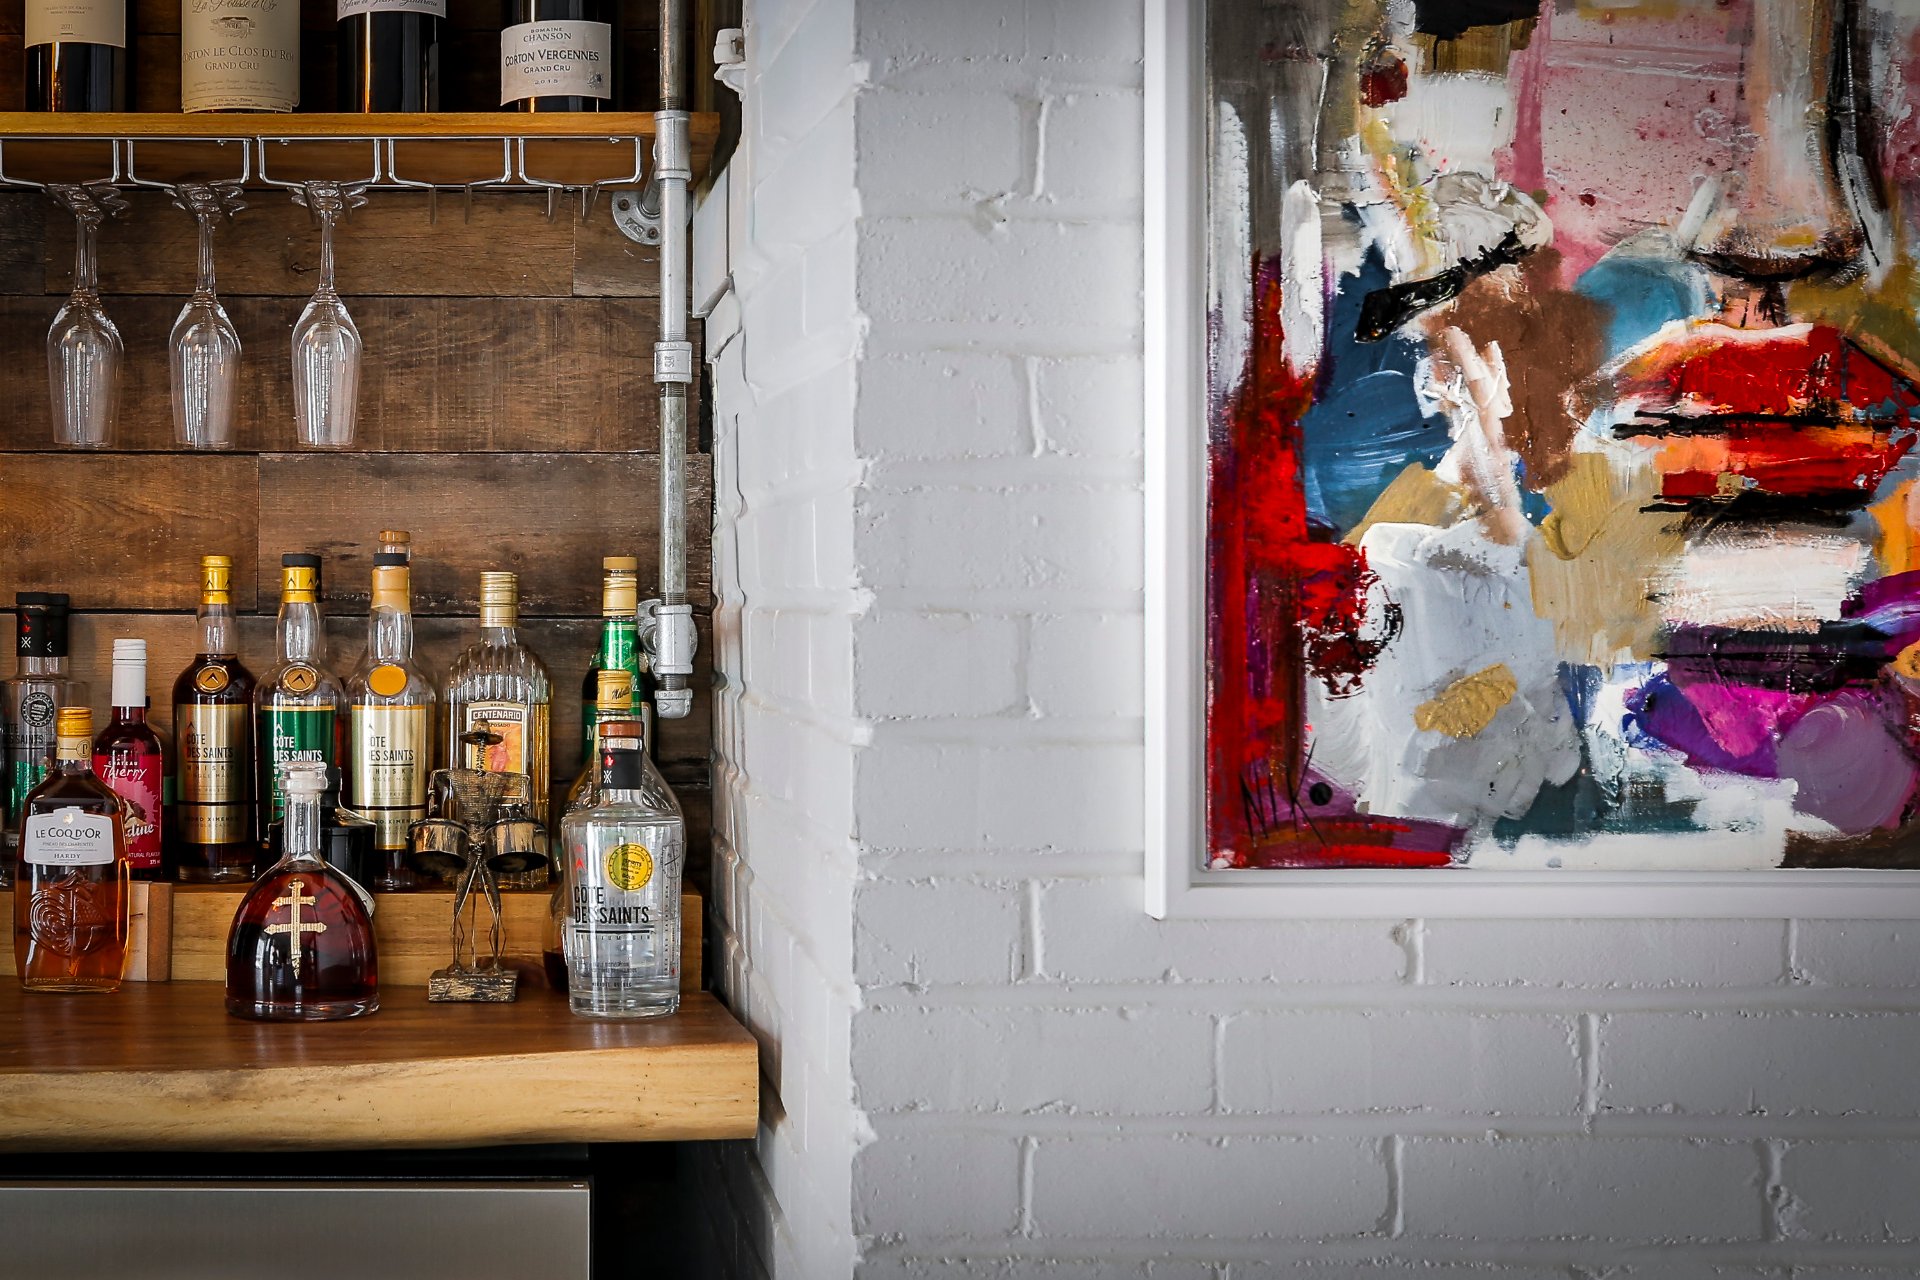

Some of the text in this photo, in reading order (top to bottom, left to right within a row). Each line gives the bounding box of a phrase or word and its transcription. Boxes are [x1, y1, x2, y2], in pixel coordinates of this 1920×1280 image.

[523, 32, 573, 43] CHANSON
[213, 47, 226, 57] LE
[228, 45, 259, 57] CLOS
[262, 48, 277, 58] DU
[505, 49, 600, 68] CORTON VERGENNES
[204, 60, 260, 71] GRAND CRU
[523, 64, 571, 74] GRAND CRU
[472, 710, 521, 720] CENTENARIO
[203, 747, 234, 759] SAINTS
[273, 749, 323, 762] DES SAINTS
[383, 749, 414, 761] SAINTS
[35, 827, 101, 840] LE COQ D'OR
[600, 906, 649, 924] SAINTS
